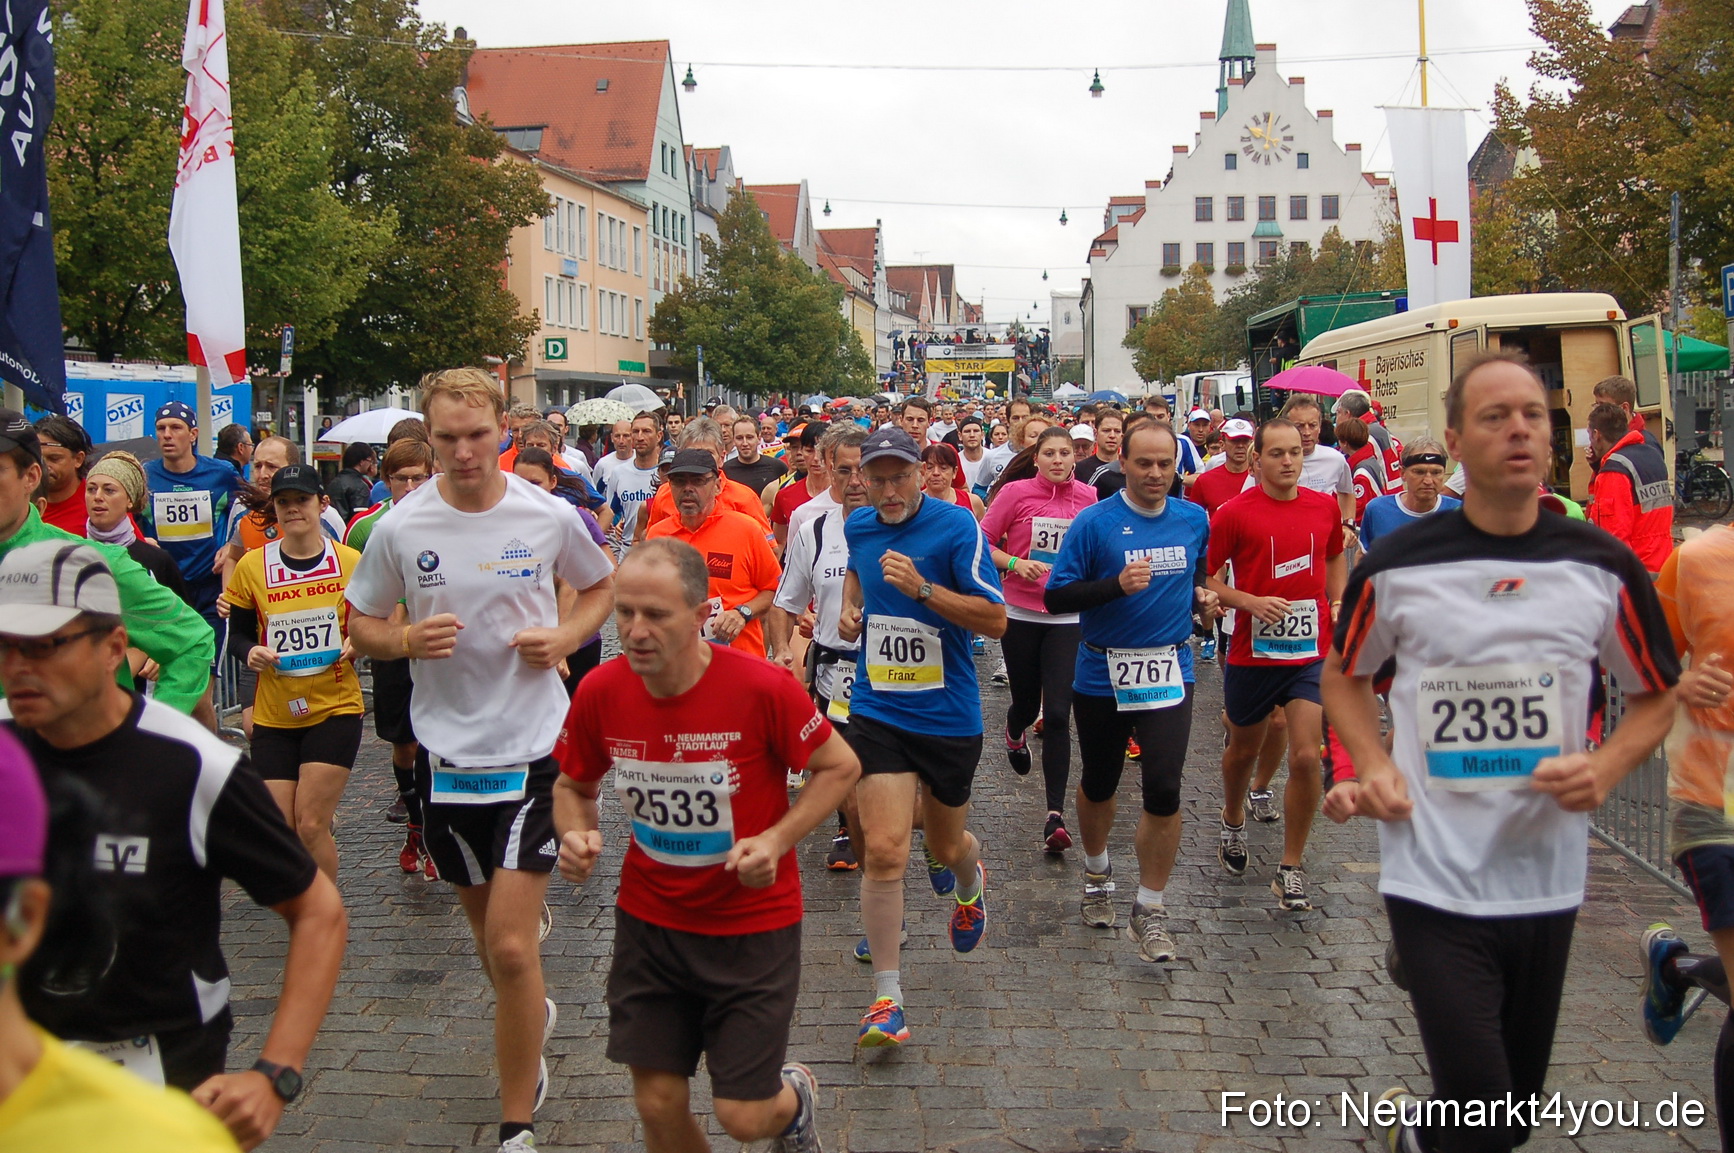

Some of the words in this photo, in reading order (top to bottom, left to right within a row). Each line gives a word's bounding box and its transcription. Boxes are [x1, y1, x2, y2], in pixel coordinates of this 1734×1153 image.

[548, 341, 564, 357] D
[954, 362, 985, 370] START
[1376, 350, 1425, 377] Bayerisches
[1375, 378, 1399, 398] Rotes
[166, 504, 199, 523] 581
[1037, 530, 1066, 550] 31
[707, 557, 733, 568] Meier
[1124, 546, 1187, 565] HUBER
[418, 573, 446, 583] PARTL
[419, 580, 447, 589] Neumarkt
[268, 589, 302, 603] MAX
[307, 582, 345, 597] BÖGL
[291, 615, 325, 625] Neumarkt
[868, 622, 889, 631] PARTL
[1259, 616, 1312, 637] 2325
[274, 624, 333, 653] 2957
[1268, 642, 1302, 651] Andreas
[879, 635, 926, 663] 406
[290, 657, 323, 668] Andrea
[888, 669, 916, 681] Franz
[1116, 659, 1173, 686] 2767
[1420, 680, 1463, 692] PARTL
[1467, 677, 1533, 691] Neumarkt
[1127, 689, 1168, 701] Bernhard
[1432, 695, 1549, 743] 2335
[663, 734, 677, 743] 11.
[677, 732, 742, 742] NEUMARKTER
[675, 741, 729, 751] STADTLAUF
[1462, 755, 1522, 774] Martin
[451, 777, 507, 791] Jonathan
[617, 768, 648, 782] PARTL
[651, 773, 705, 784] Neumarkt
[626, 786, 719, 827] 2533
[651, 832, 701, 851] Werner
[538, 848, 558, 857] adidas
